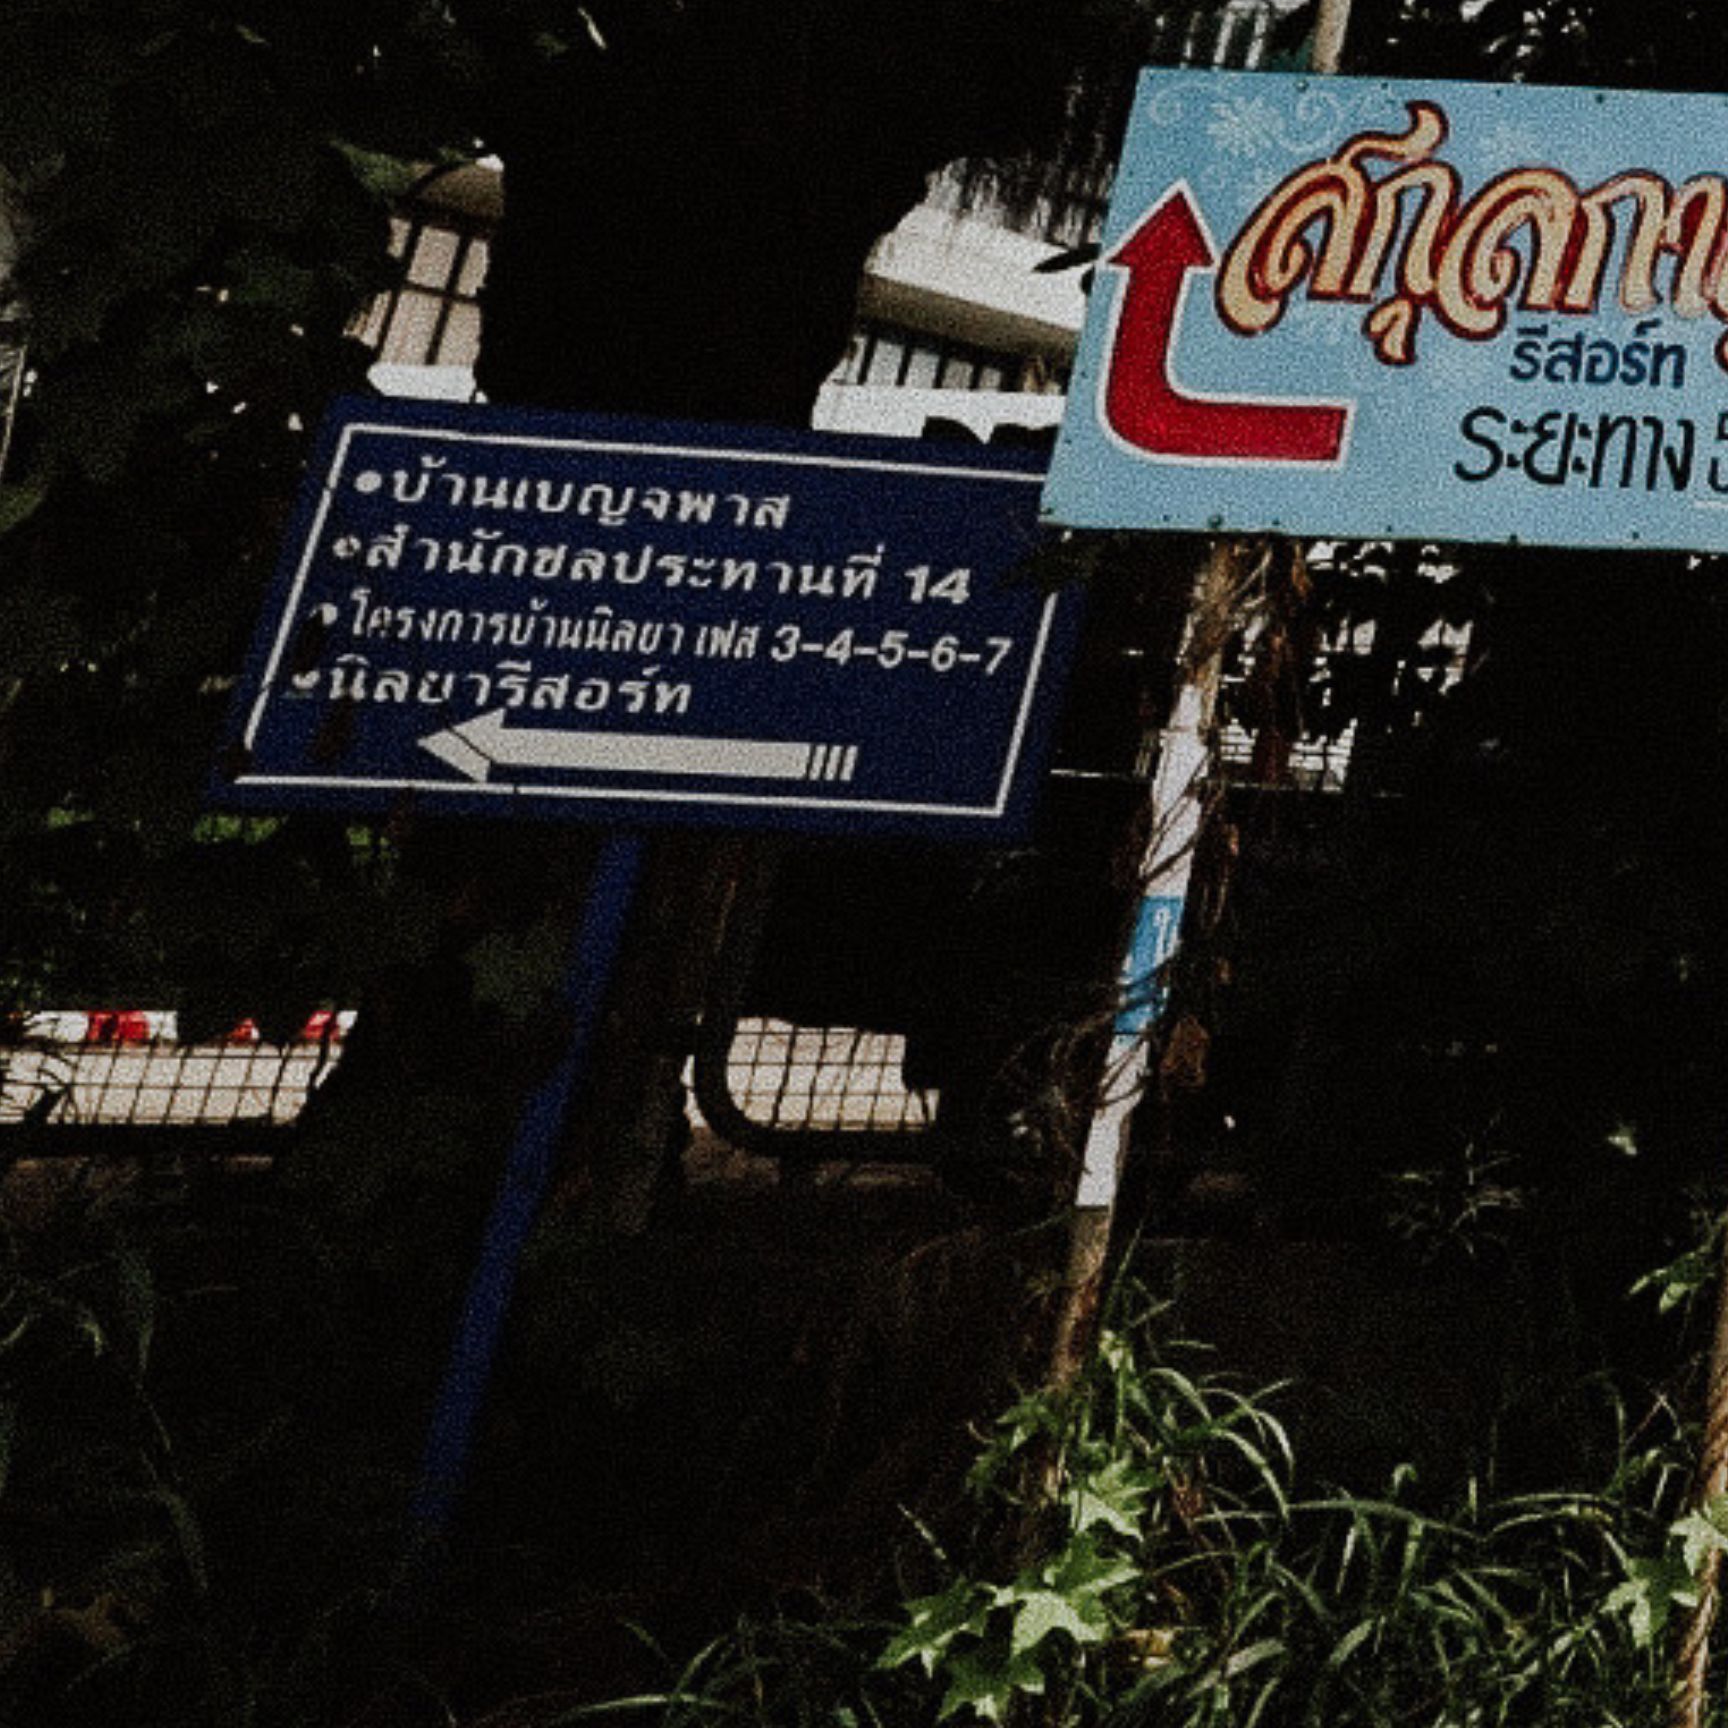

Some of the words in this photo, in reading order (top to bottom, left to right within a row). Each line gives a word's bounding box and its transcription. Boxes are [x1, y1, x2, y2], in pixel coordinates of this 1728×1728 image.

[1510, 318, 1687, 388] รีสอร์ท
[1454, 405, 1695, 491] ระยะทาง
[391, 454, 791, 531] บ้านเบญจพาส
[364, 522, 886, 599] สำนักชลประทานที่
[904, 564, 972, 605] 14
[693, 618, 761, 660] เฟส
[770, 623, 1014, 675] 3-4-5-6-7
